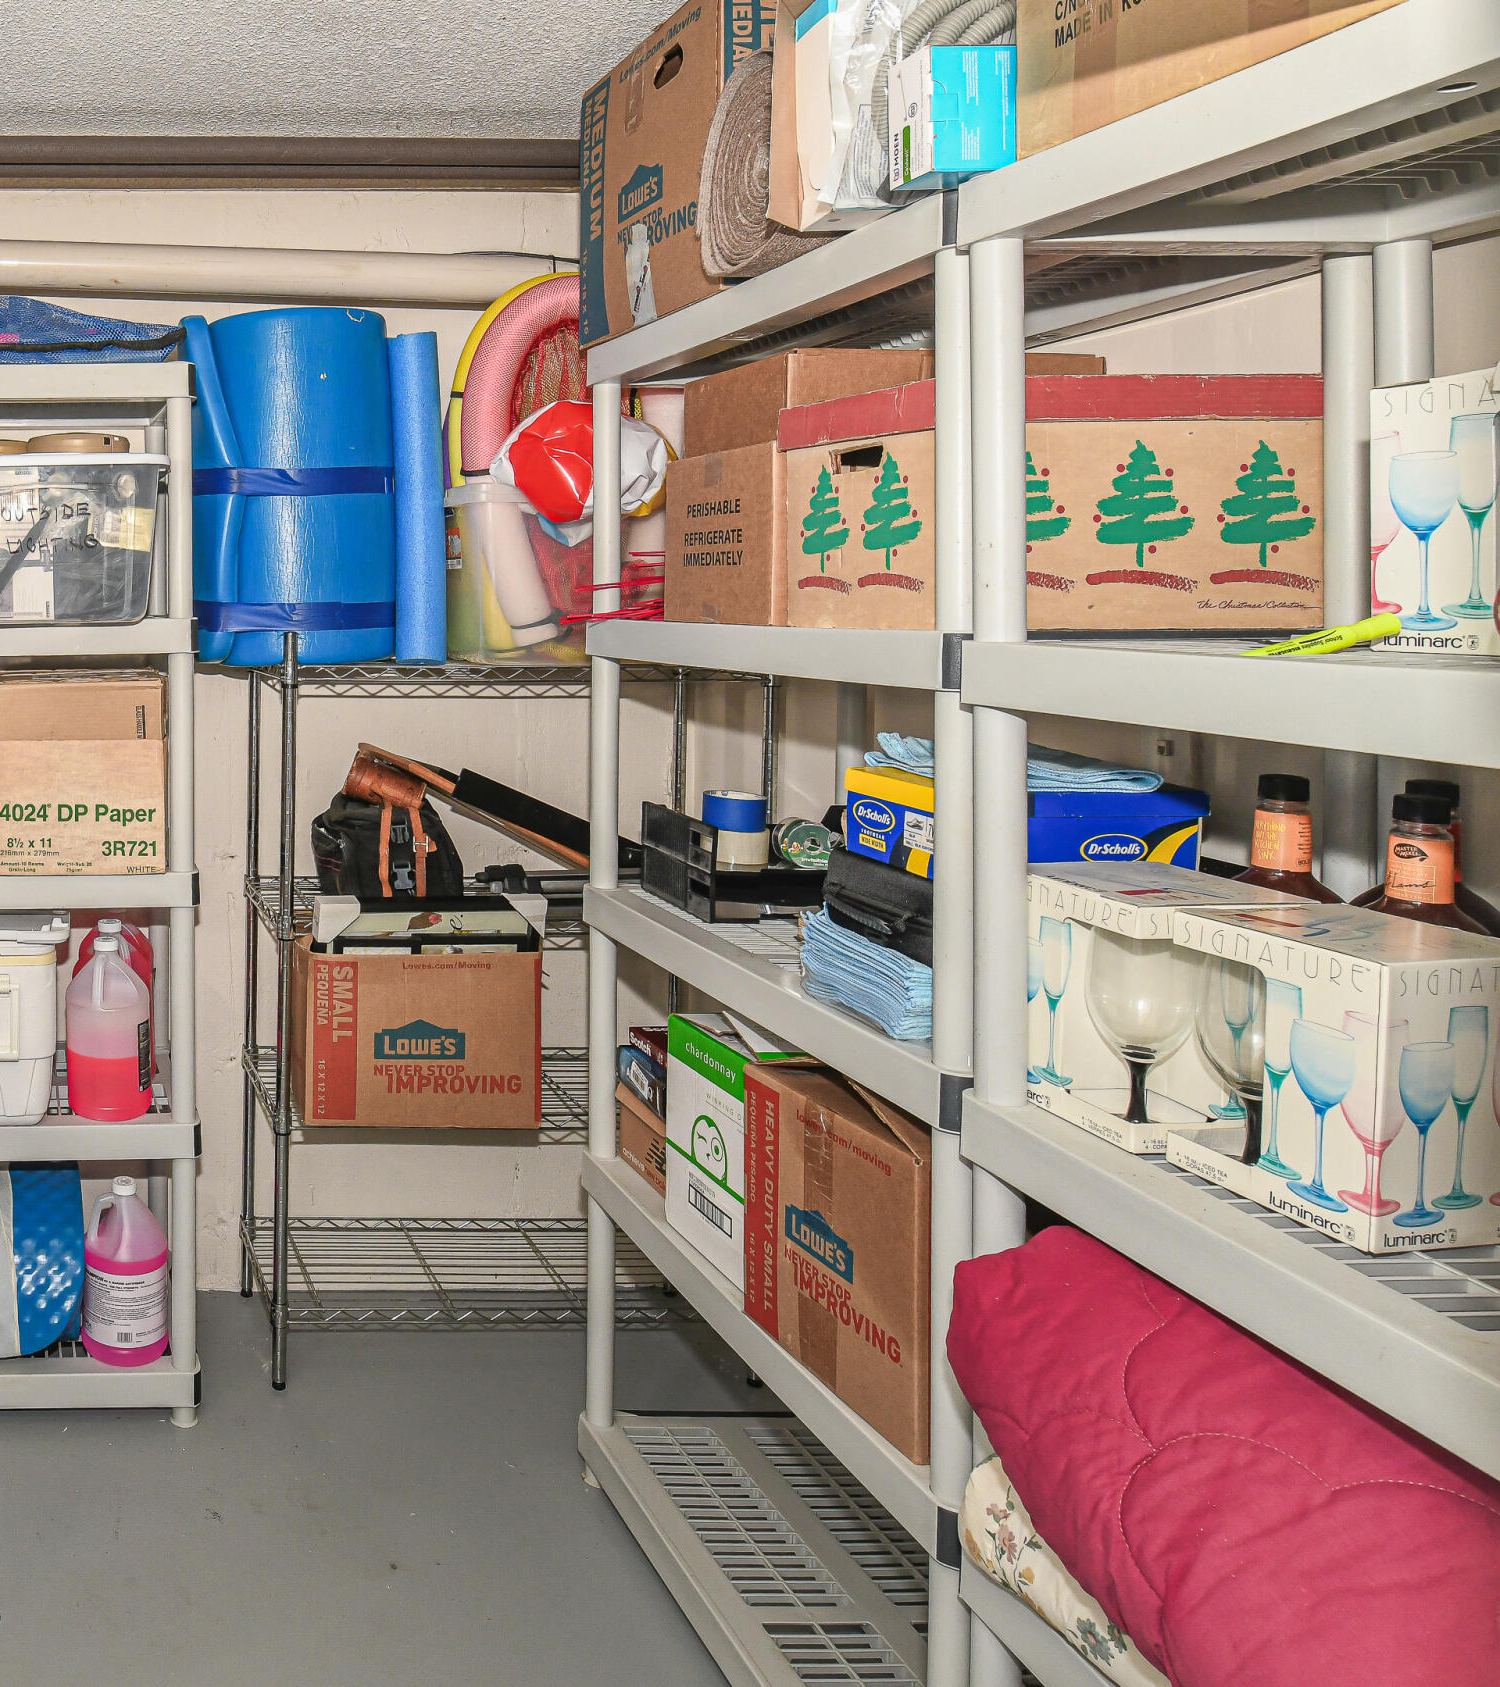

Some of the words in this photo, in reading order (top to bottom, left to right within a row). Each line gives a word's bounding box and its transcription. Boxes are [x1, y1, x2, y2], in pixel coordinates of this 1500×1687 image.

[1055, 11, 1091, 48] MADE
[1099, 0, 1113, 24] IN
[582, 100, 593, 190] MEDIANA
[590, 87, 608, 242] MEDIUM
[621, 176, 658, 215] LOWE'S
[642, 207, 663, 226] STOP
[1, 502, 91, 525] OUTSIDE
[686, 498, 741, 519] PERISHABLE
[6, 533, 99, 554] LIGHTING
[683, 527, 743, 547] REFRIGERATE
[683, 549, 743, 567] IMMEDIATELY
[1197, 598, 1217, 609] The
[57, 804, 88, 822] DP
[95, 804, 156, 827] Paper
[0, 849, 25, 857] 216mm
[33, 849, 60, 857] 279mm
[28, 840, 35, 848] x
[39, 838, 52, 848] 11
[101, 840, 157, 857] 3R721
[402, 961, 492, 970] Lowes.com/Moving
[1184, 920, 1365, 992] SIGNATURE
[316, 964, 331, 1026] PEQUEÑA
[332, 965, 354, 1043] SMALL
[383, 1035, 457, 1056] LOWE'S
[629, 1031, 652, 1057] Scotch
[318, 1059, 326, 1071] 16
[373, 1064, 422, 1077] NEVER
[426, 1064, 465, 1077] STOP
[685, 1041, 737, 1084] chardonnay
[318, 1072, 326, 1080] X
[387, 1074, 522, 1095] IMPROVING
[317, 1082, 325, 1093] 12
[317, 1094, 325, 1102] X
[317, 1103, 325, 1114] 12
[764, 1099, 776, 1172] HEAVY
[749, 1152, 757, 1203] PESADO
[1185, 1161, 1205, 1174] COPAS
[1202, 1162, 1216, 1172] ICED
[1217, 1169, 1228, 1178] TEA
[764, 1174, 776, 1234] DUTY
[1269, 1191, 1342, 1235] luminarc
[791, 1213, 847, 1272] LOWE'S
[1383, 1231, 1446, 1248] luminarc
[763, 1240, 775, 1312] SMALL
[784, 1244, 820, 1281] NEVER
[821, 1271, 852, 1301] STOP
[793, 1263, 902, 1364] IMPROVING
